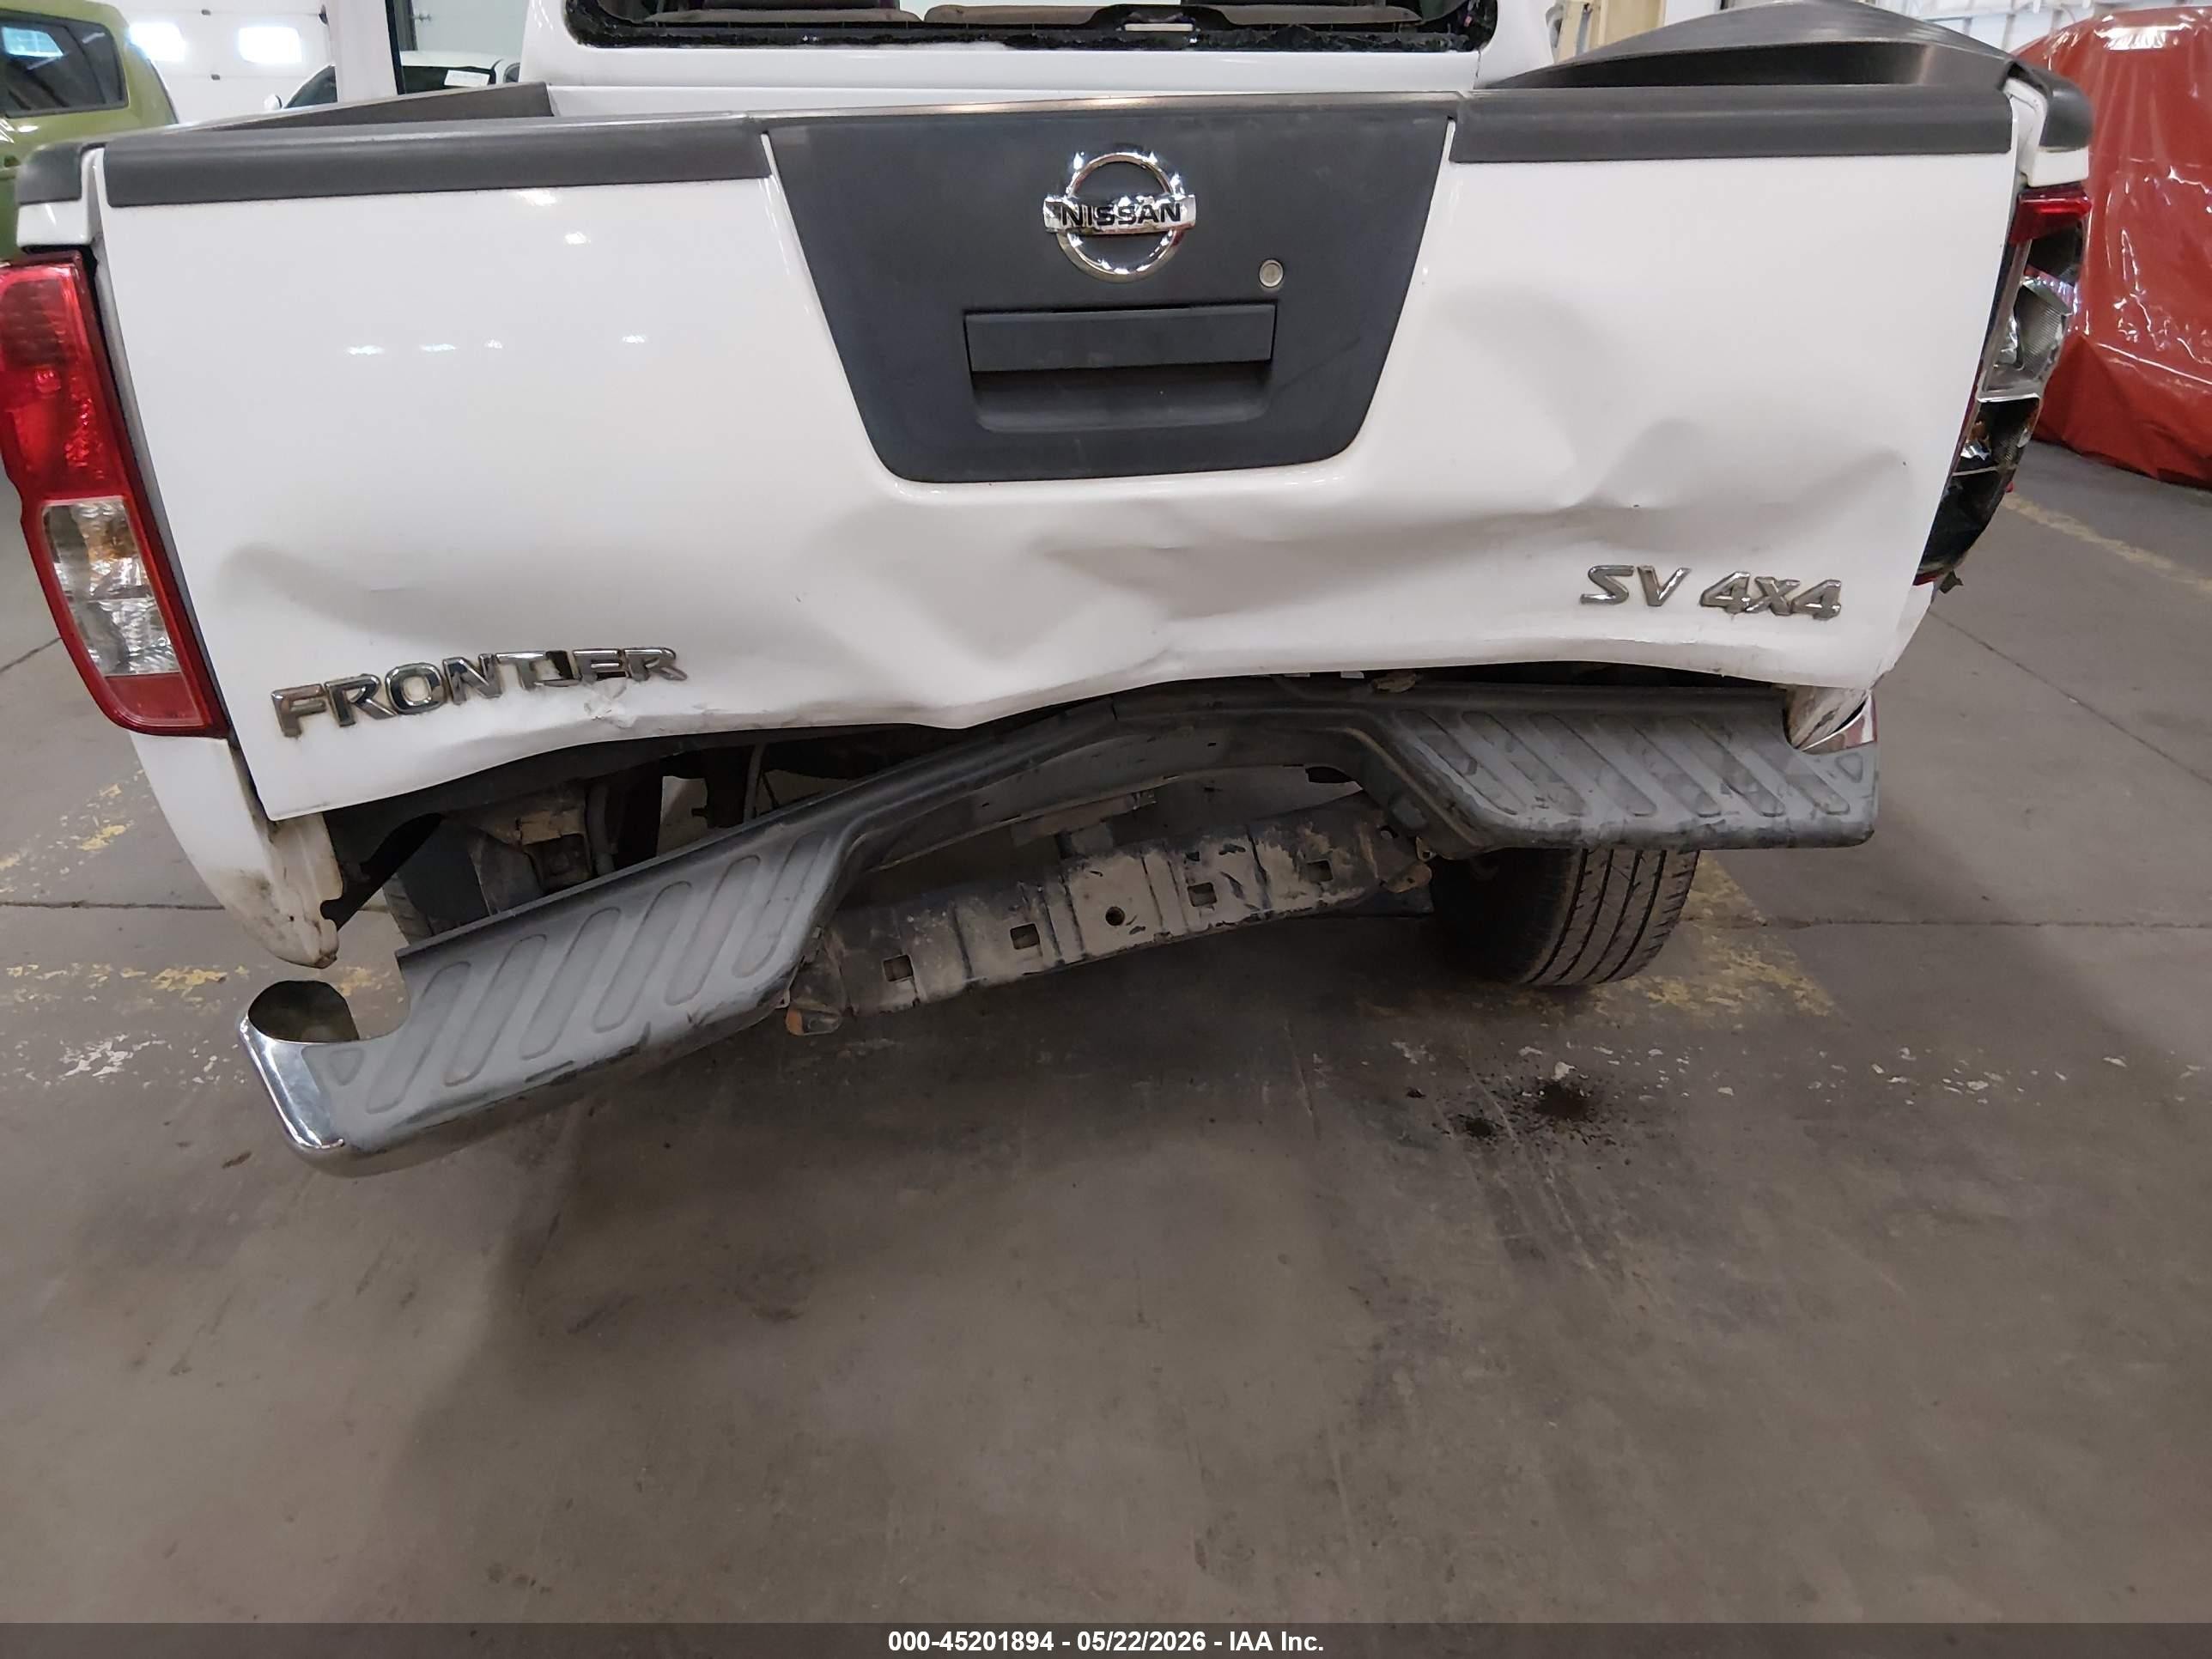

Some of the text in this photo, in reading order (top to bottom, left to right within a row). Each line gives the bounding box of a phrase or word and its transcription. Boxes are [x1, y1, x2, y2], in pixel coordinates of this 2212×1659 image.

[1060, 203, 1182, 226] NISSAN
[1580, 564, 1691, 606] SV
[270, 647, 687, 738] FRONTIER
